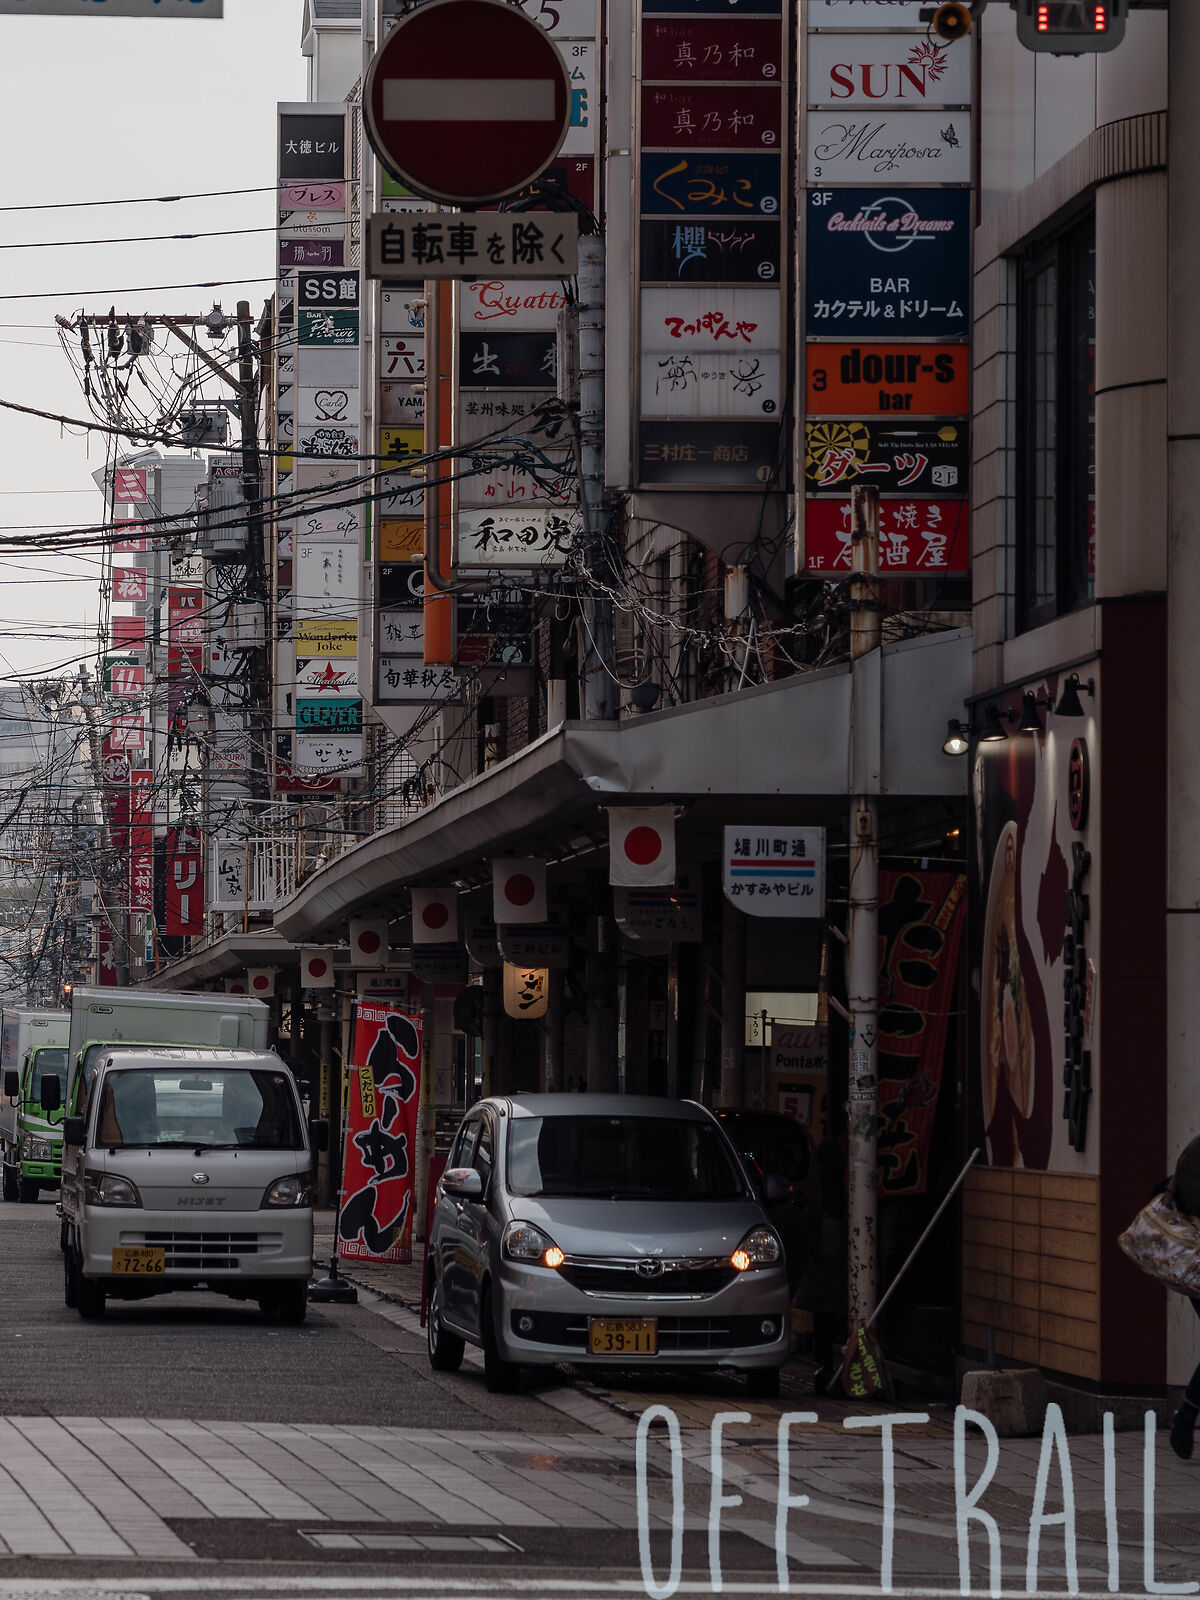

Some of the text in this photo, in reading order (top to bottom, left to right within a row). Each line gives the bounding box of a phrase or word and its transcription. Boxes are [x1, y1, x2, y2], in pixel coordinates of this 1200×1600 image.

[572, 46, 588, 57] 3F
[673, 42, 755, 68] 真乃和
[830, 63, 929, 99] SUN
[673, 108, 754, 135] 真乃和
[285, 140, 340, 154] 大徳ビル
[814, 122, 943, 172] Mariposa
[576, 163, 588, 171] 2F
[814, 167, 822, 177] 3
[653, 160, 754, 210] くみこ
[812, 193, 833, 206] 3F
[827, 212, 887, 232] Cocktails
[900, 211, 955, 232] Dreams
[380, 221, 565, 266] 自転車を除く
[305, 279, 357, 300] SS館
[870, 278, 910, 293] BAR
[840, 348, 955, 385] dour-s
[812, 369, 827, 391] 3
[879, 390, 913, 410] bar
[465, 402, 525, 417] 芸州味処
[644, 444, 749, 462] 三村庄一商店
[818, 448, 928, 486] ダーツ
[301, 548, 312, 561] 3F
[809, 557, 824, 568] 1F
[316, 641, 343, 652] Joke
[384, 668, 456, 689] 旬華秋冬
[300, 706, 358, 724] CLEVER
[734, 838, 806, 857] 堀川町通
[731, 882, 814, 898] かすみやビル
[123, 1258, 162, 1273] 72-66
[603, 1333, 651, 1351] 39-11
